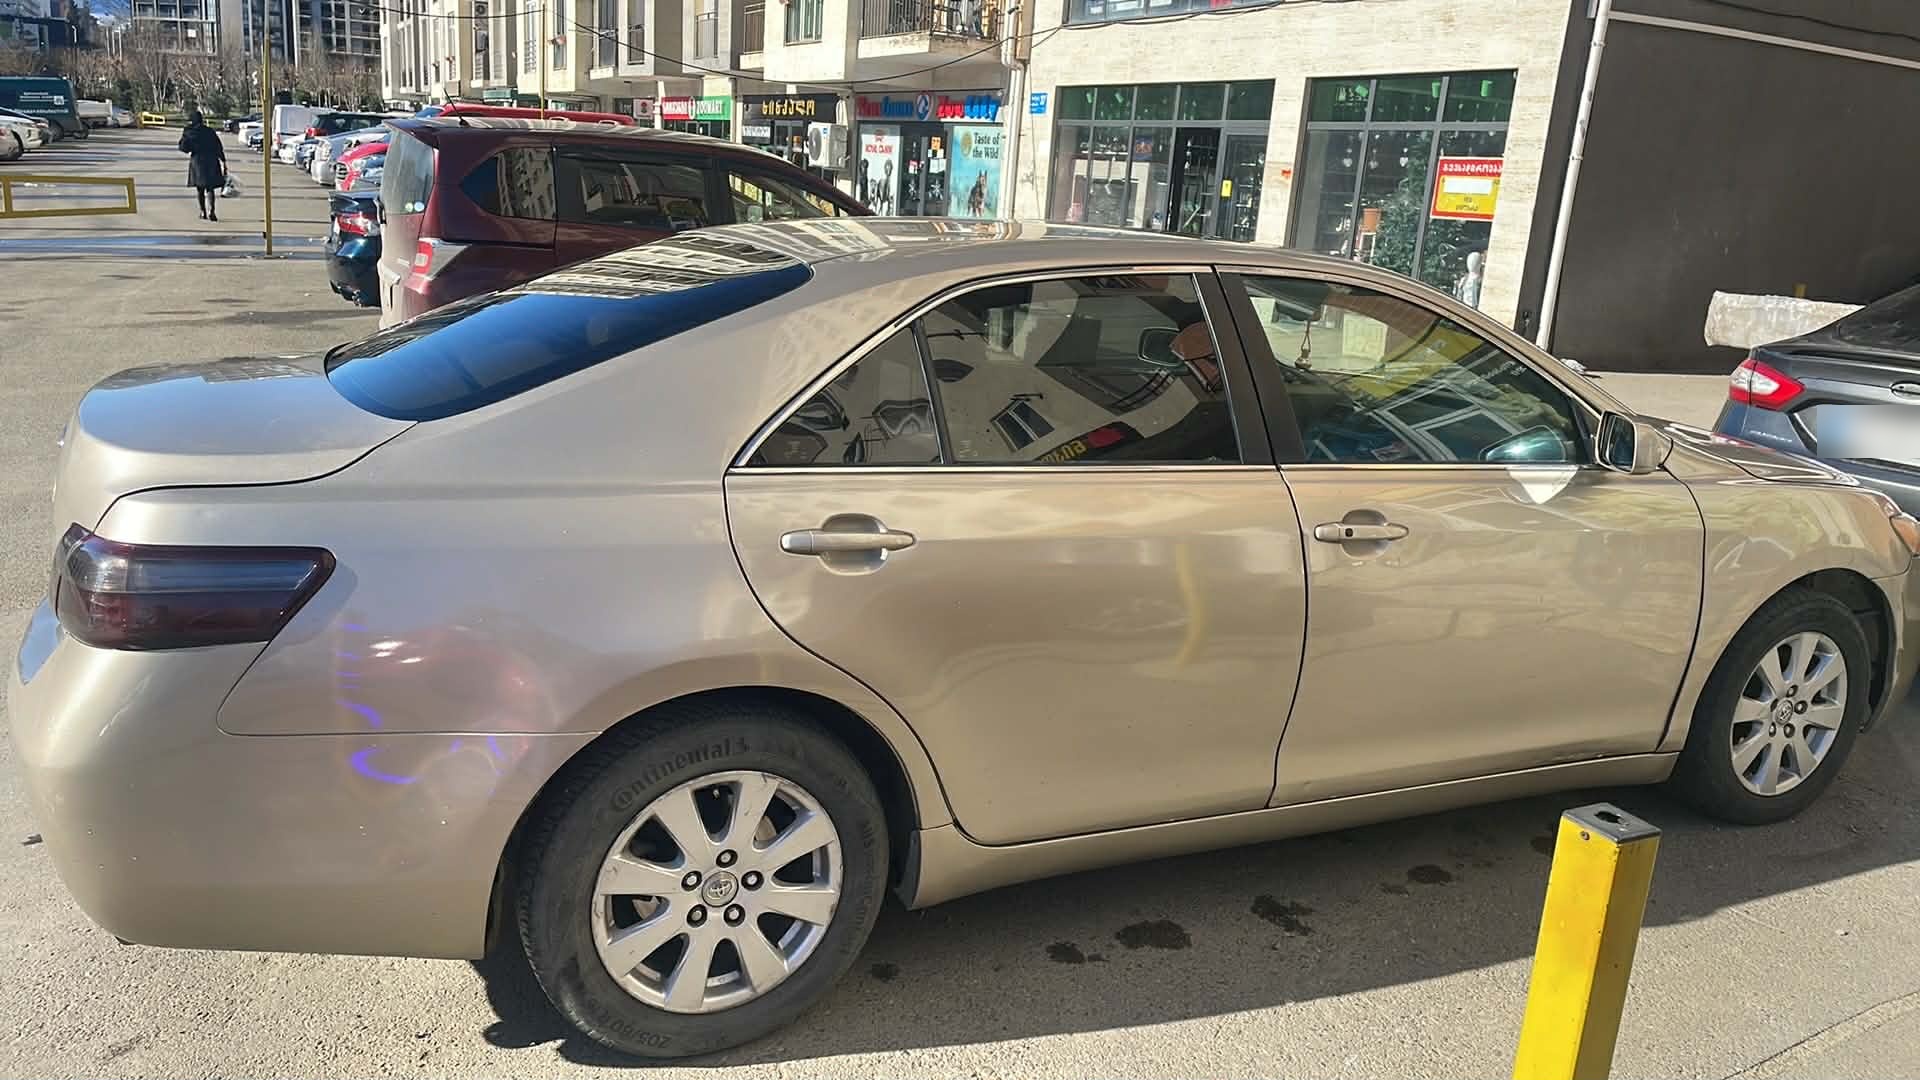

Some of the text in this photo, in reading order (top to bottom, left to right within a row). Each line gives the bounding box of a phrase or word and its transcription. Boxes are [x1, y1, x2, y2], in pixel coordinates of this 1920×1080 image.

[974, 132, 1001, 146] Taste of
[972, 148, 999, 159] the Wild
[609, 737, 731, 812] Continental
